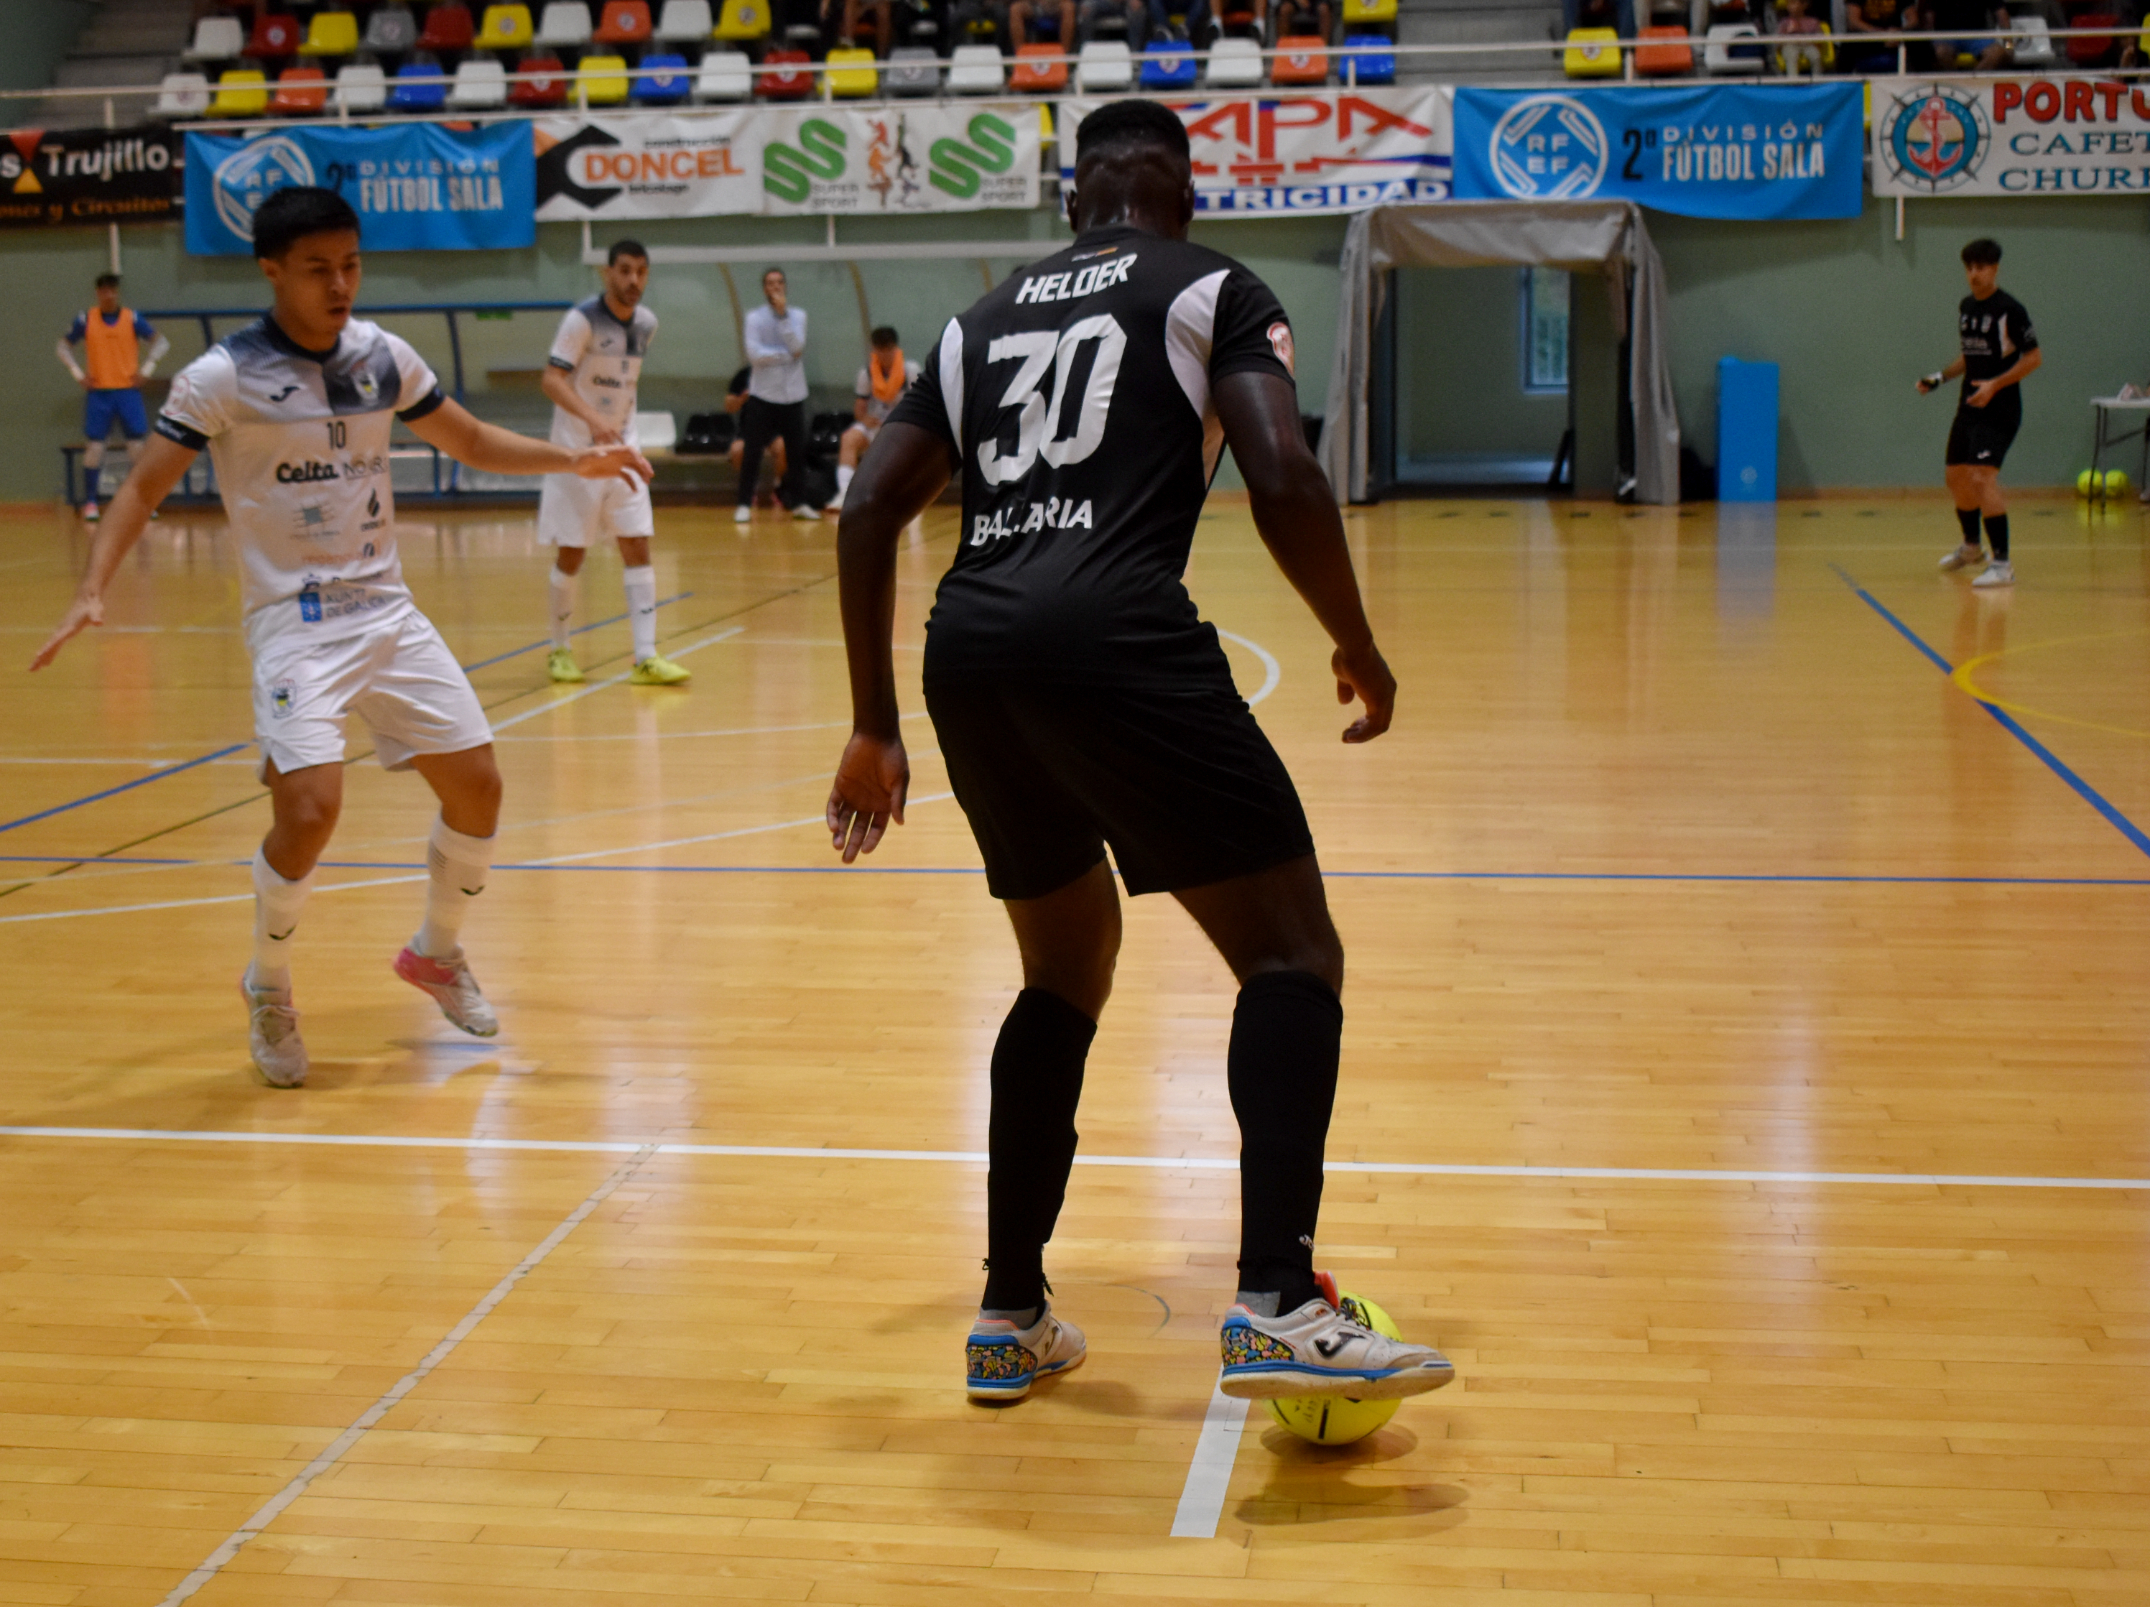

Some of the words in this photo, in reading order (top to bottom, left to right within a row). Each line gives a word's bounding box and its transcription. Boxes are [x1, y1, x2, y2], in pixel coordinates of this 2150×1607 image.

[1663, 119, 1823, 142] DIVISIÓN
[40, 138, 170, 182] Trujillo
[584, 147, 745, 182] DONCEL
[1662, 140, 1755, 182] FÚTBOL
[1763, 142, 1825, 180] SALA
[448, 176, 504, 212] SALA
[1197, 181, 1450, 210] TRICIDAD
[1016, 253, 1137, 304] HELDER
[977, 313, 1127, 486] 30
[326, 420, 346, 450] 10
[276, 461, 339, 484] Celta
[969, 496, 1092, 547] BALARIA
